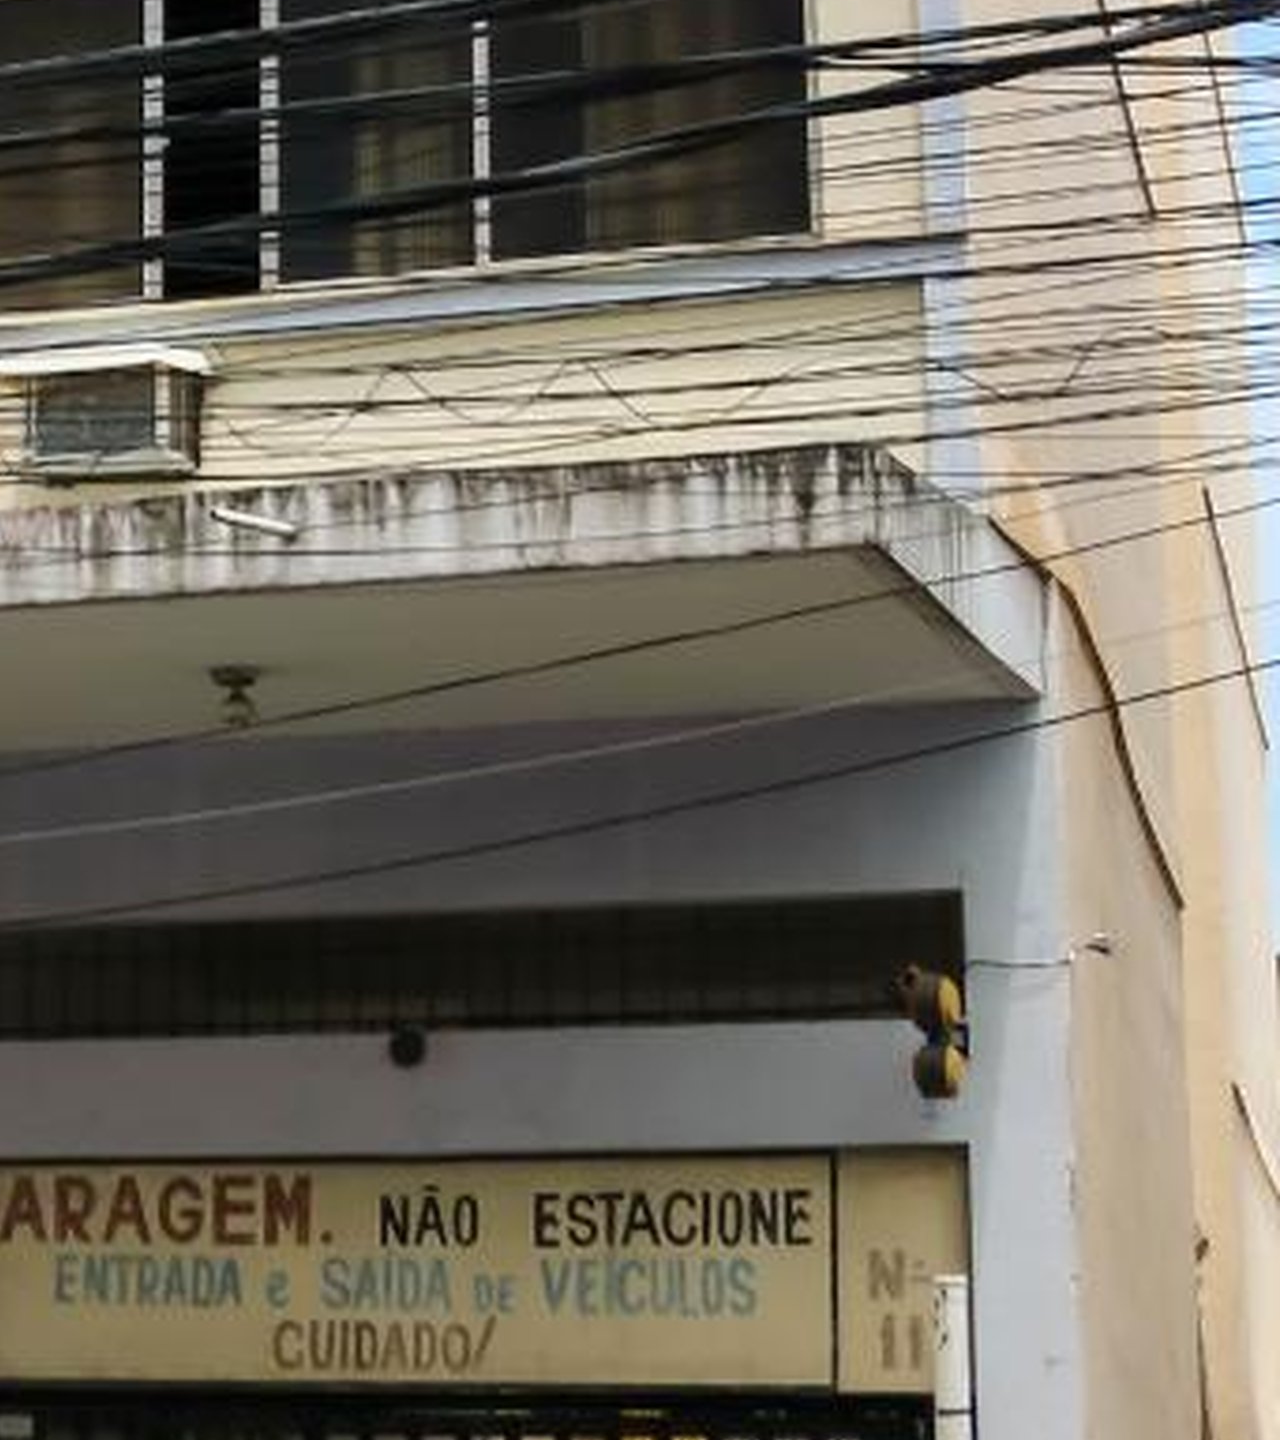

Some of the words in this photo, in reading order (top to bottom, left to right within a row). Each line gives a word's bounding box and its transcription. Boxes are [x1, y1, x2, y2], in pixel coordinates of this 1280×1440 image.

[379, 1185, 478, 1247] NÃO
[533, 1190, 812, 1247] ESTACIONE
[54, 1253, 242, 1305] ENTRADA
